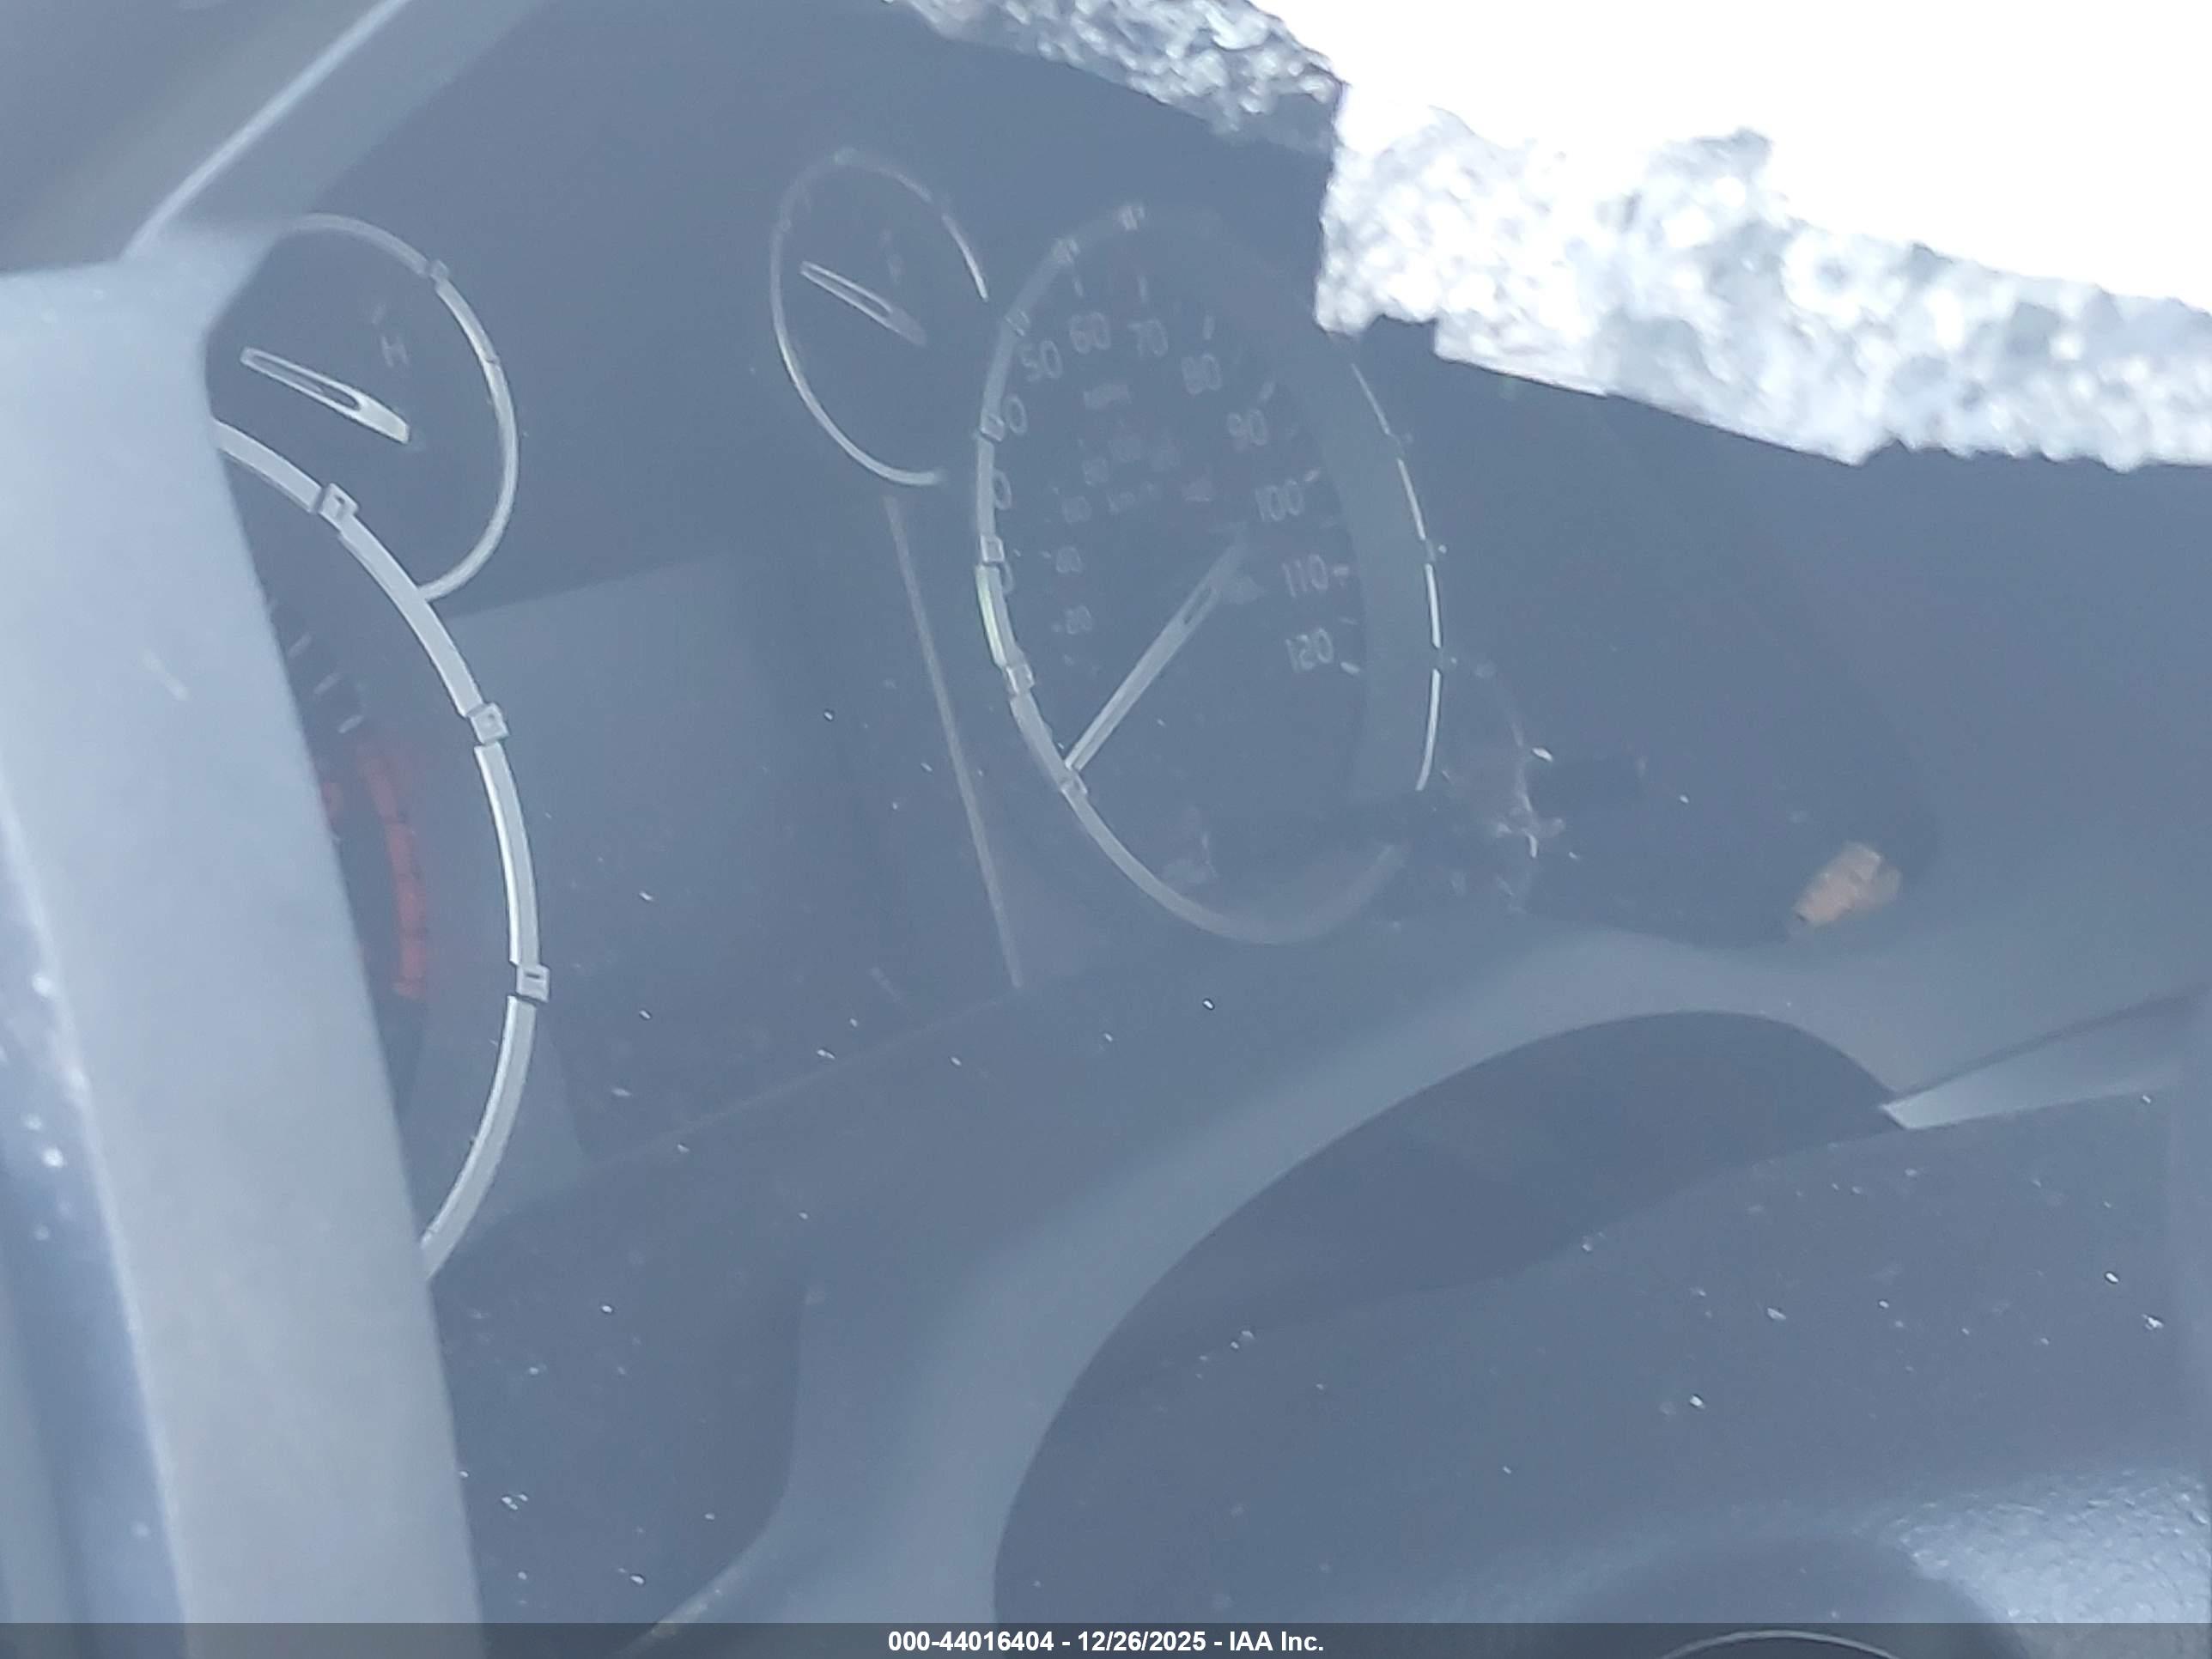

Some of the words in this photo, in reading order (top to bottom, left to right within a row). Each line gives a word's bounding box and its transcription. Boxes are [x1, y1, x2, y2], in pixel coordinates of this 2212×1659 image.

[1068, 312, 1111, 355] 60
[1127, 319, 1169, 357] 70
[1019, 340, 1063, 382] 50
[1225, 408, 1269, 453] 90
[1255, 478, 1304, 522] 100
[1282, 554, 1329, 598] 110
[1285, 627, 1334, 673] 120
